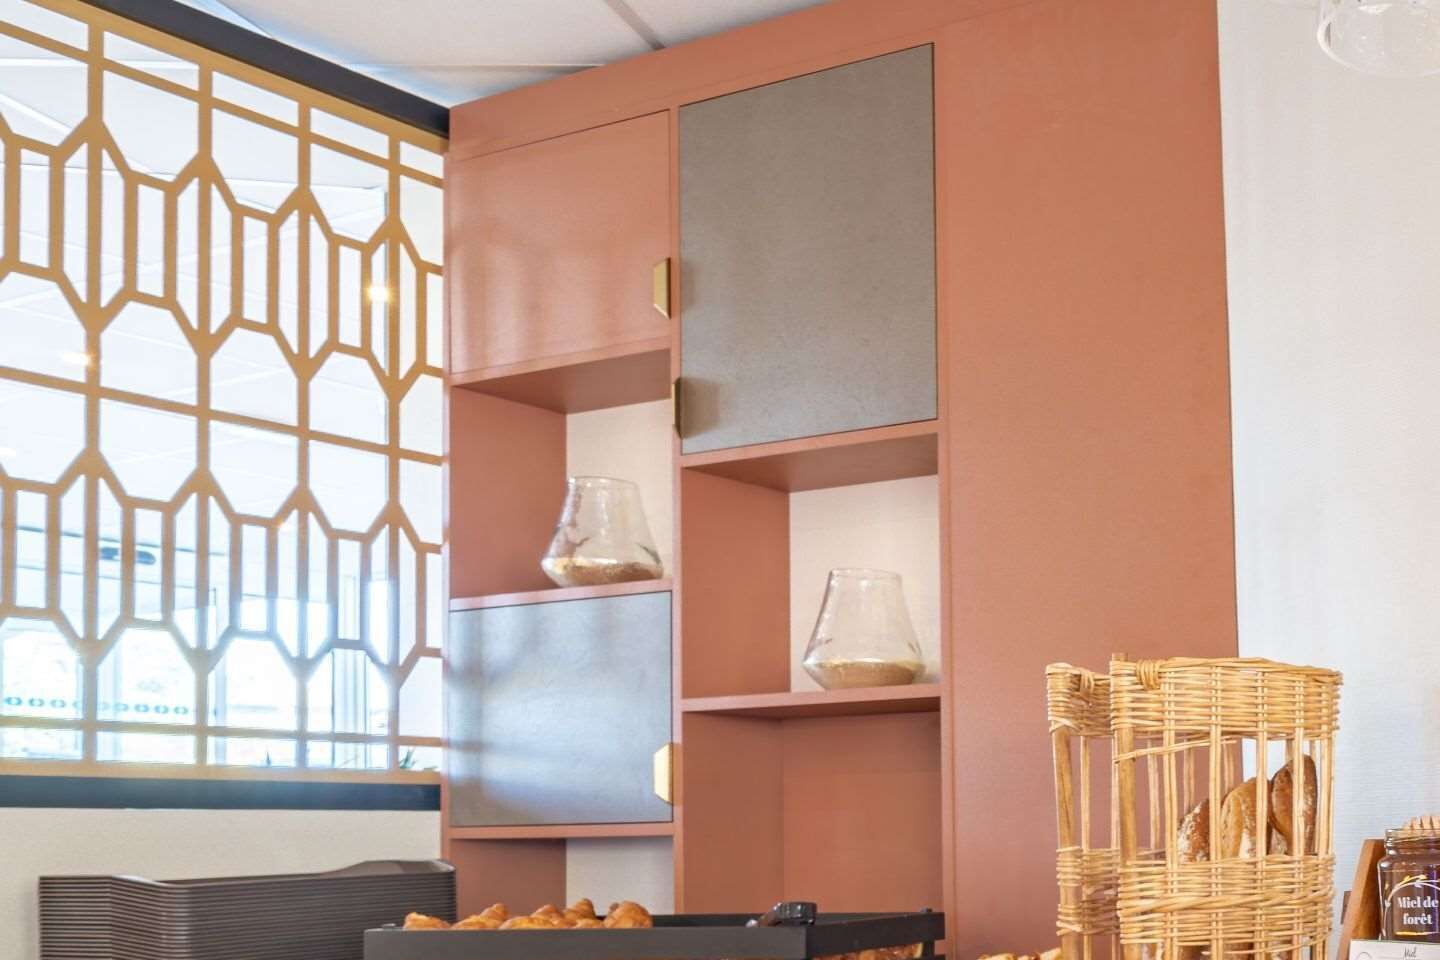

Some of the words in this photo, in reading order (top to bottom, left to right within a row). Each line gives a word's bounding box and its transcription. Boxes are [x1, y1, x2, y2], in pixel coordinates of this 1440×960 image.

[1397, 896, 1422, 908] Miel
[1423, 896, 1439, 908] de
[1402, 912, 1433, 925] forêt
